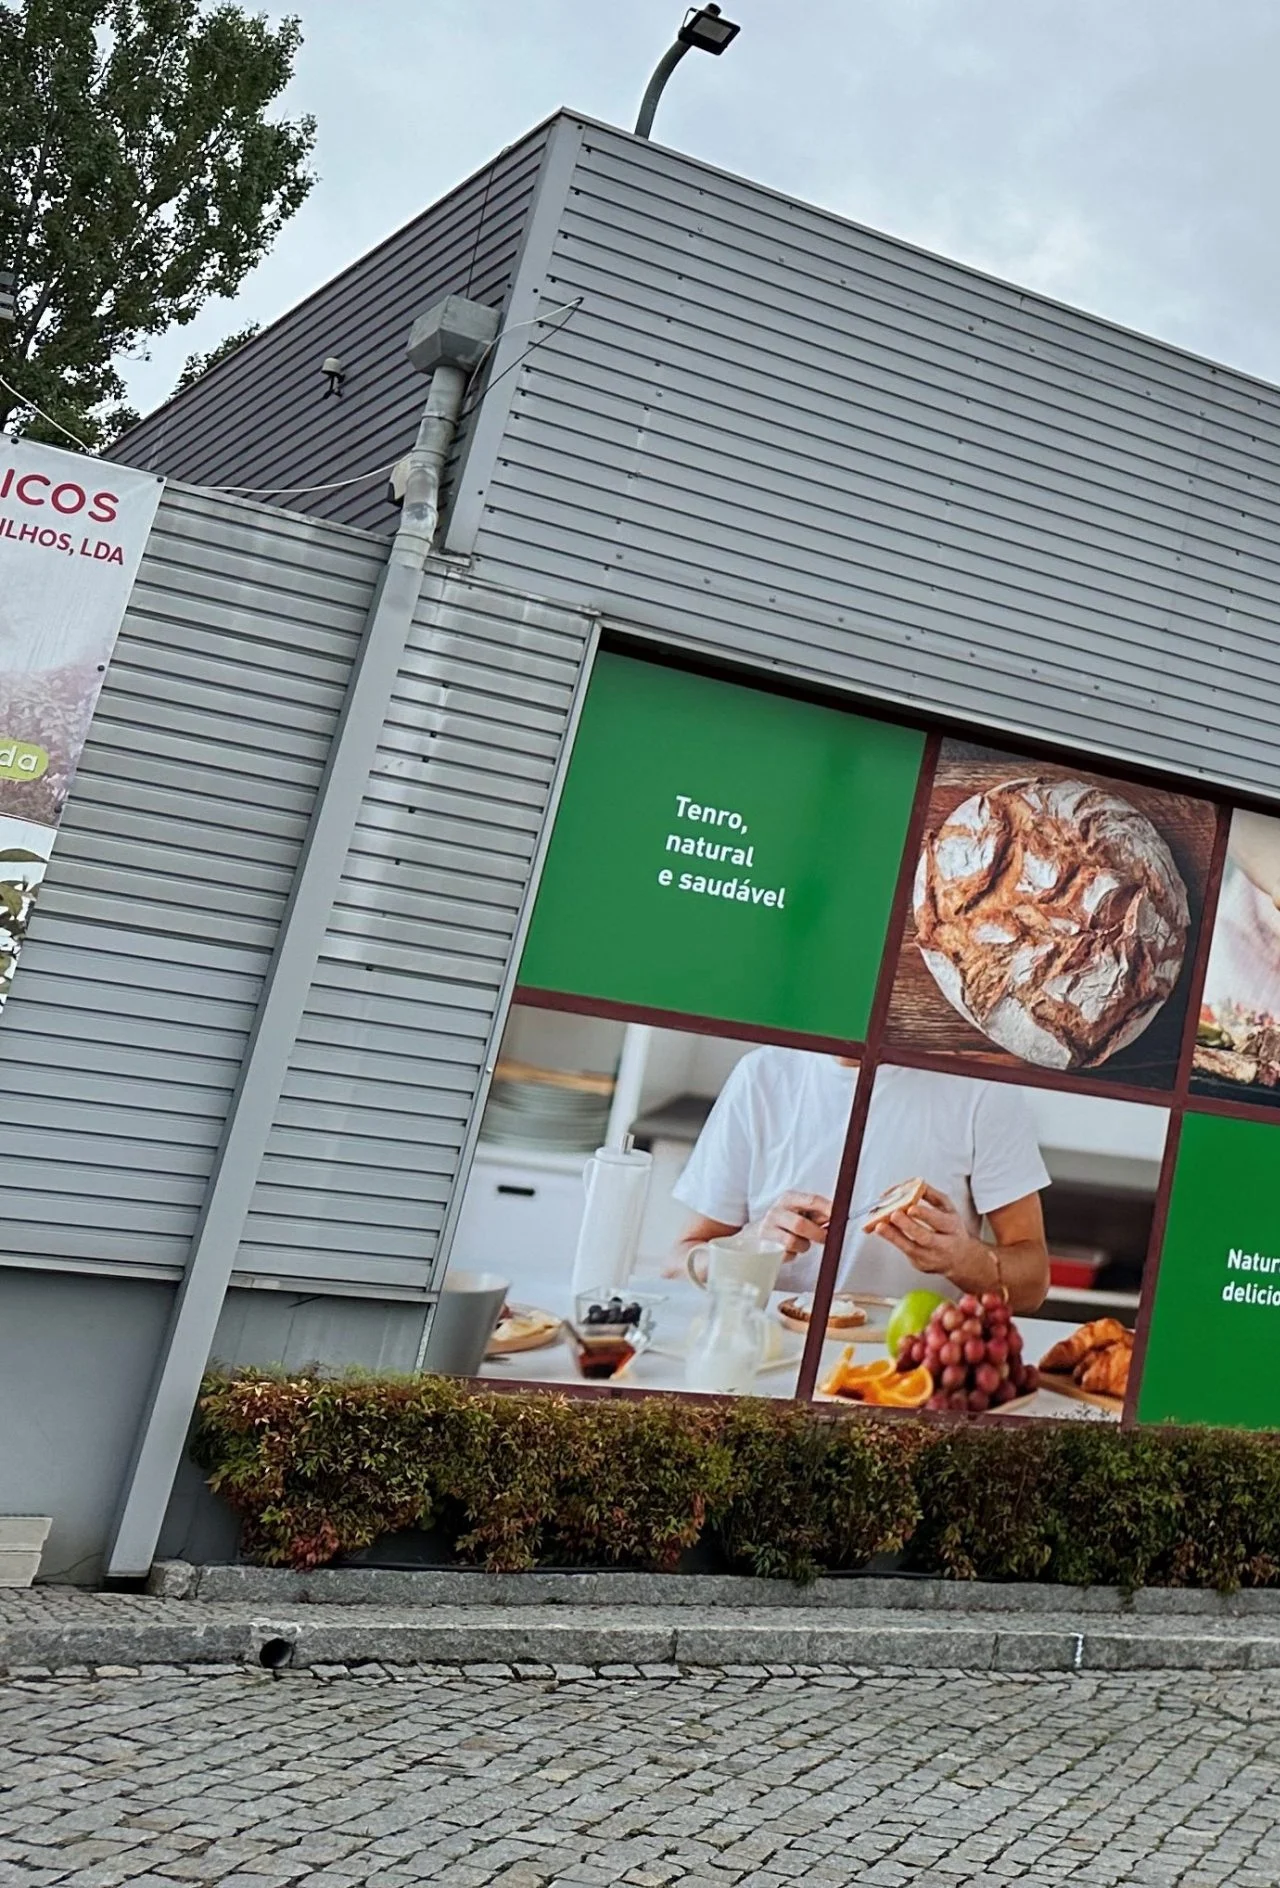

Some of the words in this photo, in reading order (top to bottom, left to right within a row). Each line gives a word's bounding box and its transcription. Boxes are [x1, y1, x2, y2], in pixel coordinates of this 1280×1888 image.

[79, 537, 124, 566] LDA
[676, 795, 748, 835] Tenro,
[665, 834, 754, 868] natural
[658, 868, 673, 886] e
[678, 872, 786, 909] saudável
